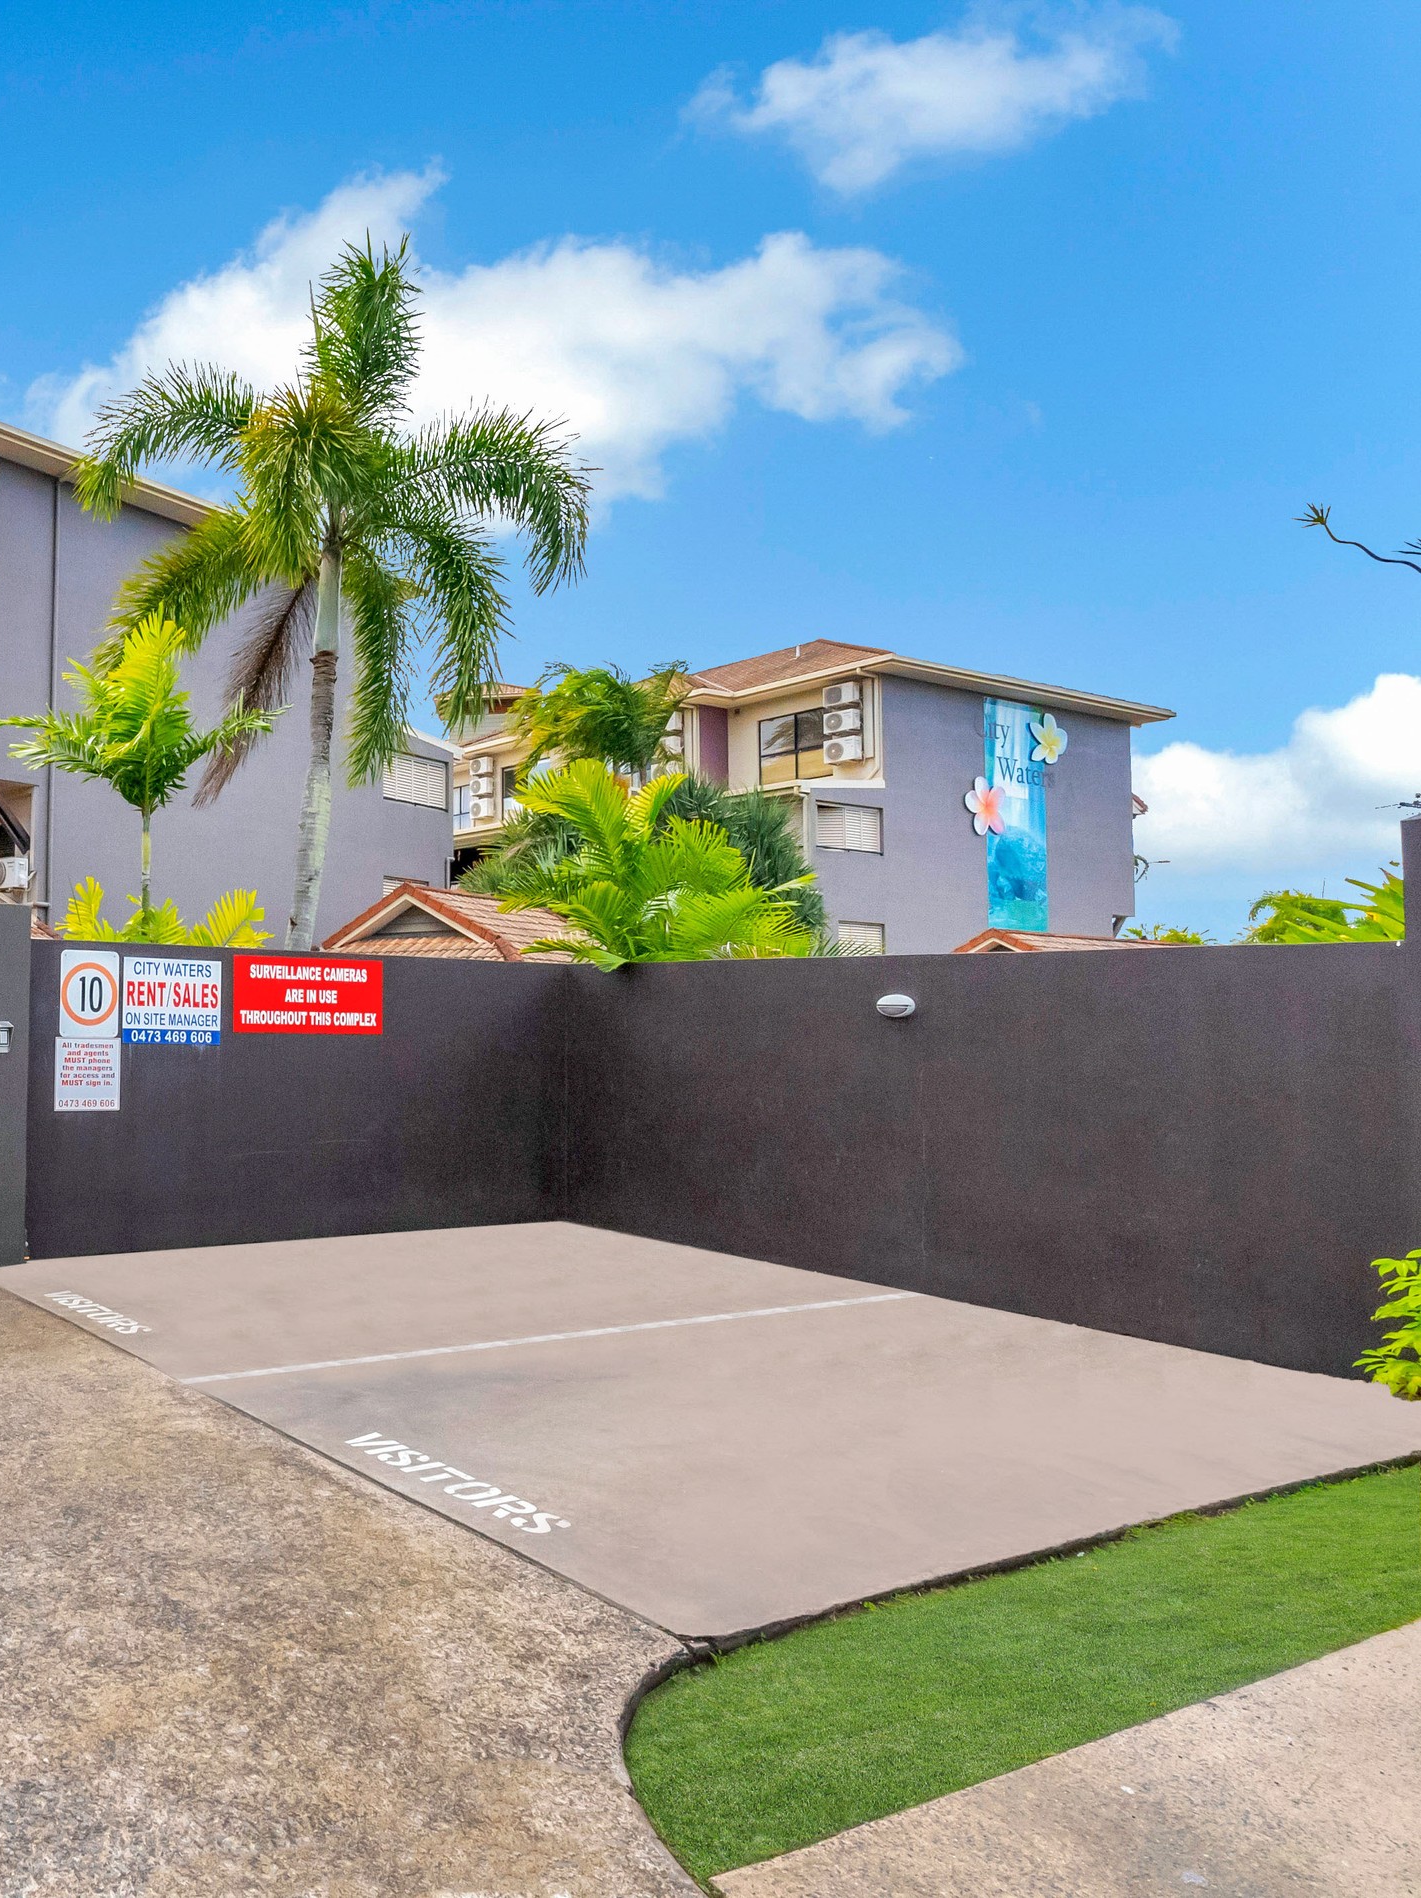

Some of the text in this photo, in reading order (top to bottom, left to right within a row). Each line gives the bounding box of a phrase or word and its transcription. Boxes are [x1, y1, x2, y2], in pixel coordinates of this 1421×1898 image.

[133, 961, 212, 978] CITY WATERS
[249, 964, 368, 983] SURVEILLANCE CAMERAS
[79, 976, 103, 1013] 10
[284, 988, 338, 1004] ARE IN USE
[125, 1012, 218, 1027] ON SITE MANAGER
[239, 1009, 377, 1027] THROUGHOUT THIS COMPLEX
[131, 1030, 212, 1044] 0473 469 606
[76, 1065, 113, 1073] managers
[58, 1099, 116, 1108] 0473 469 606
[43, 1289, 153, 1334] VISITORS
[344, 1431, 572, 1534] VISITORS
